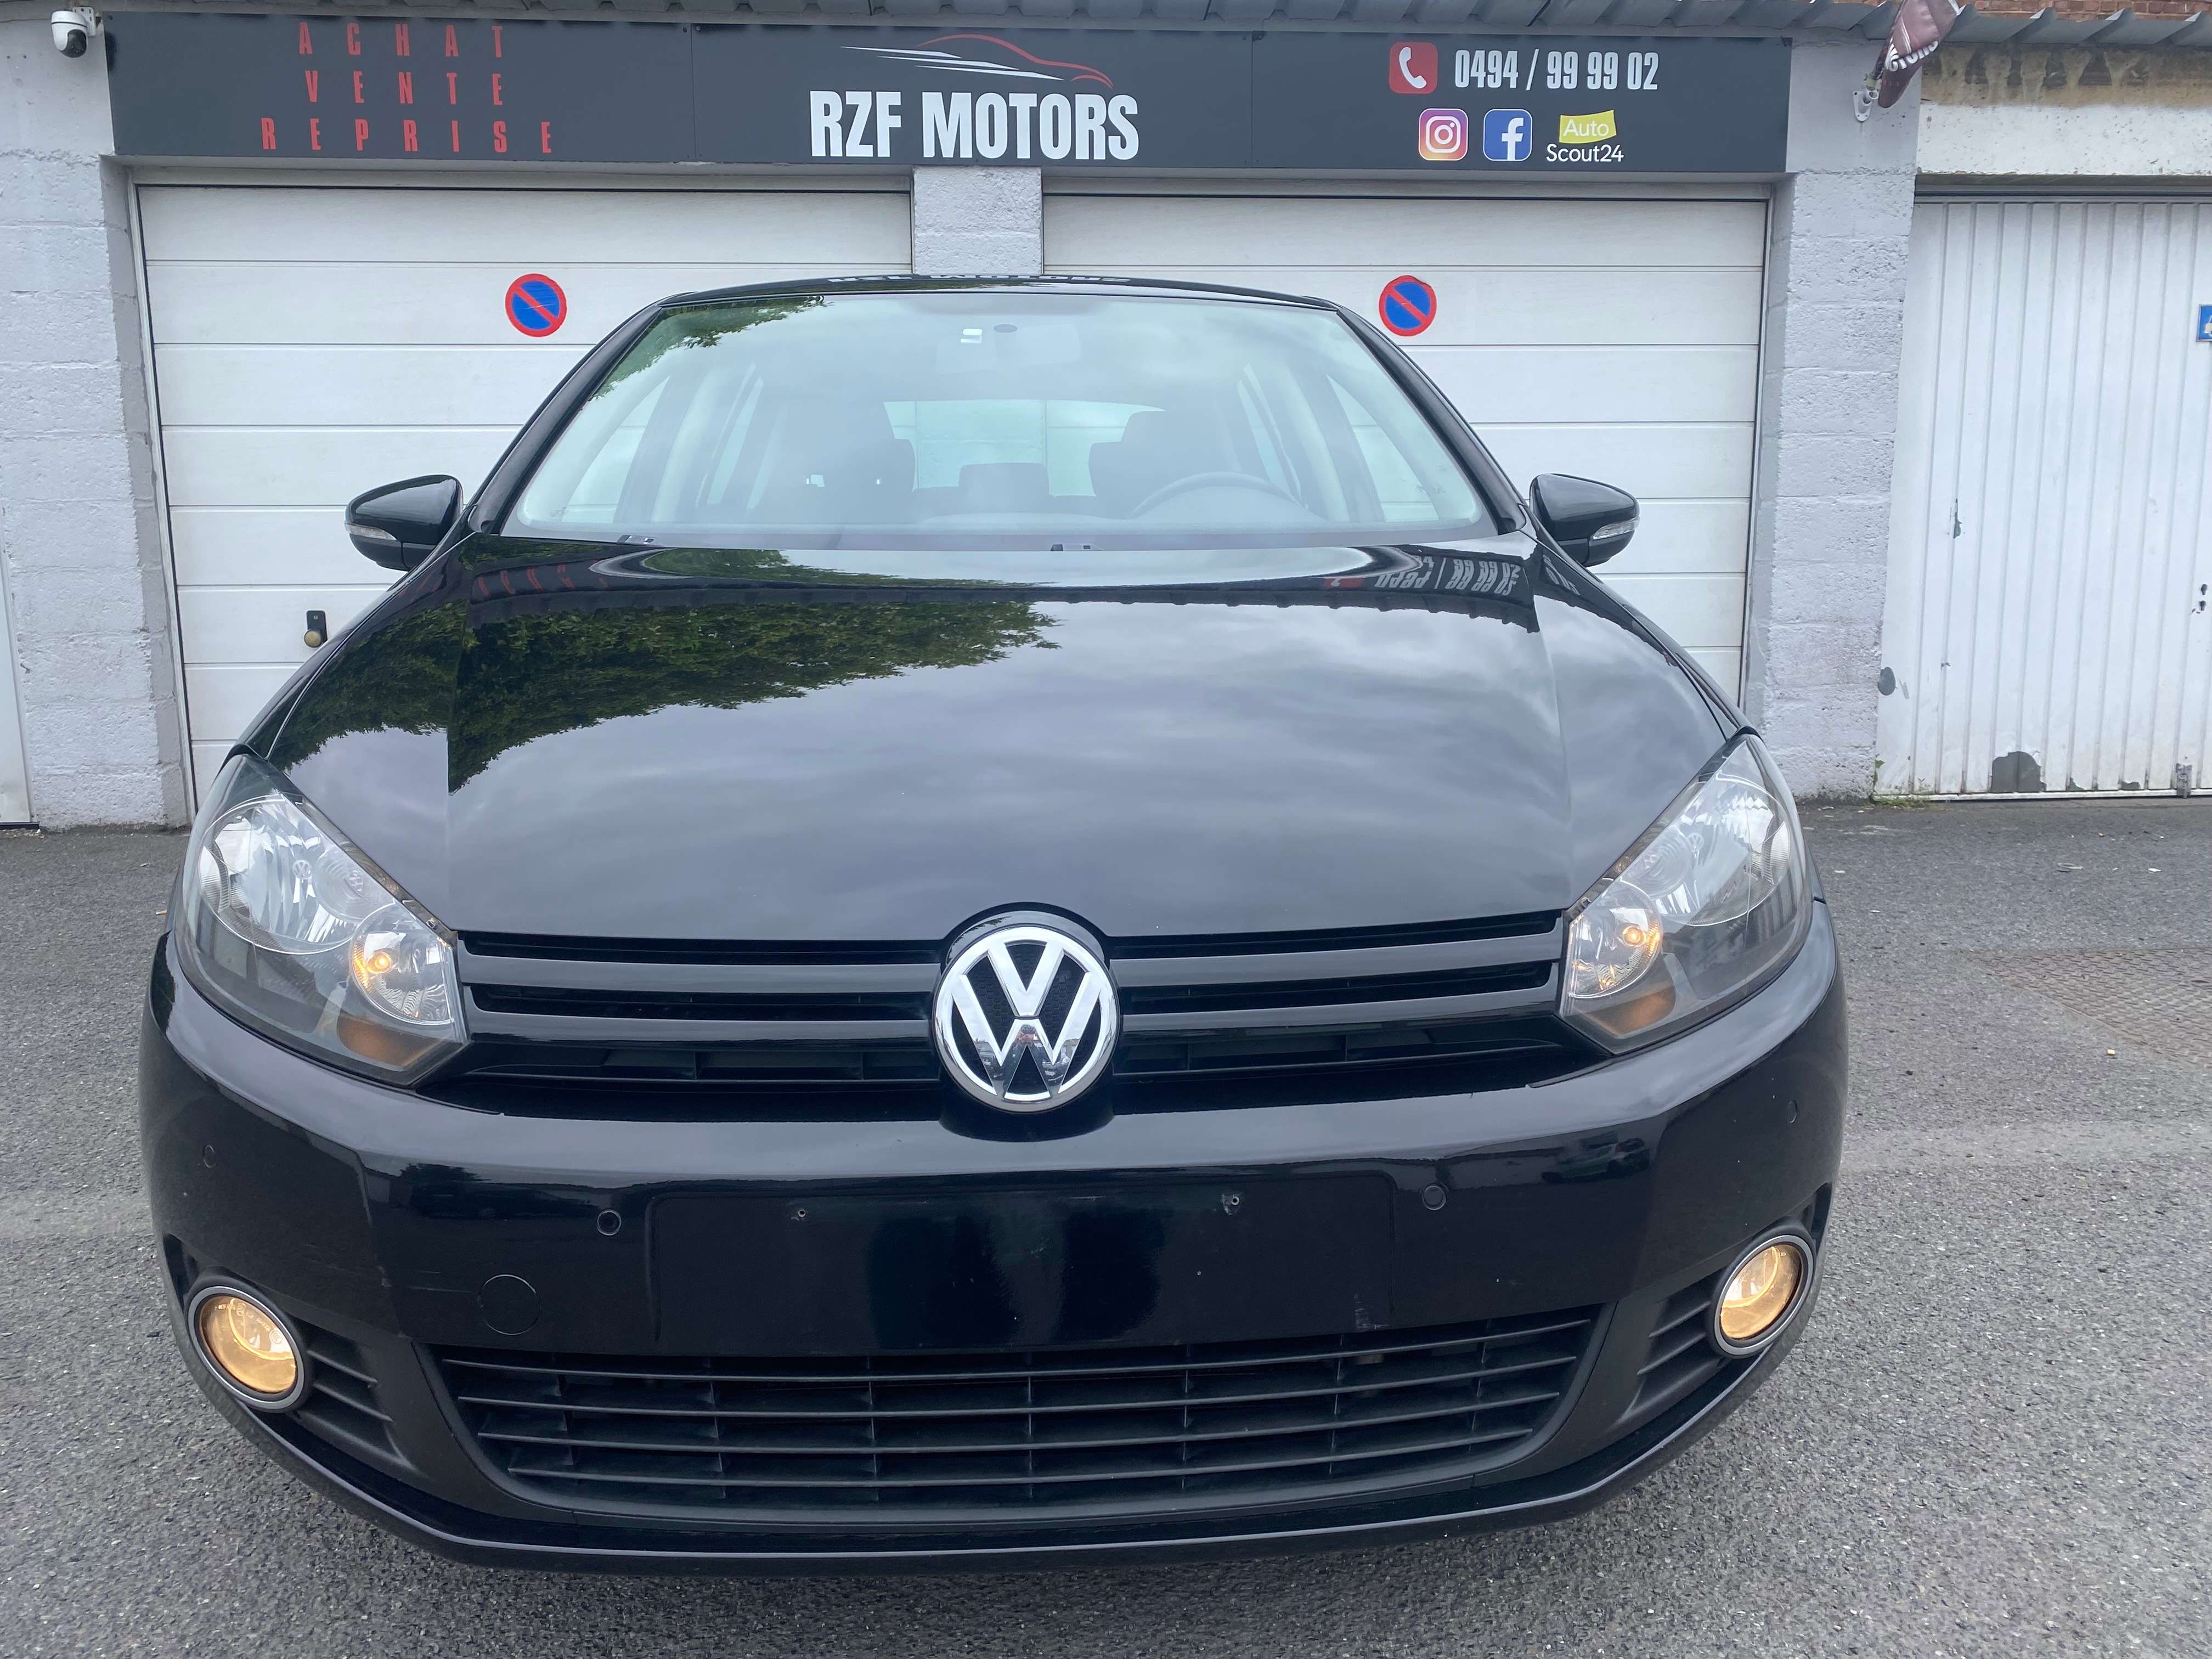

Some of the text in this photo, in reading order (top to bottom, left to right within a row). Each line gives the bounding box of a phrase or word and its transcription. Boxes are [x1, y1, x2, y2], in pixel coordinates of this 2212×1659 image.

[300, 22, 503, 58] ACHAT
[1454, 49, 1519, 89] 0494
[1547, 51, 1578, 89] 99
[1587, 52, 1618, 90] 99
[1627, 52, 1659, 90] 02
[306, 70, 503, 106] VENTE
[261, 117, 551, 154] REPRISE
[810, 91, 1139, 160] RZF MOTORS
[1562, 119, 1610, 137] Auto
[1546, 144, 1624, 162] Scout24
[934, 926, 1119, 1111] VW
